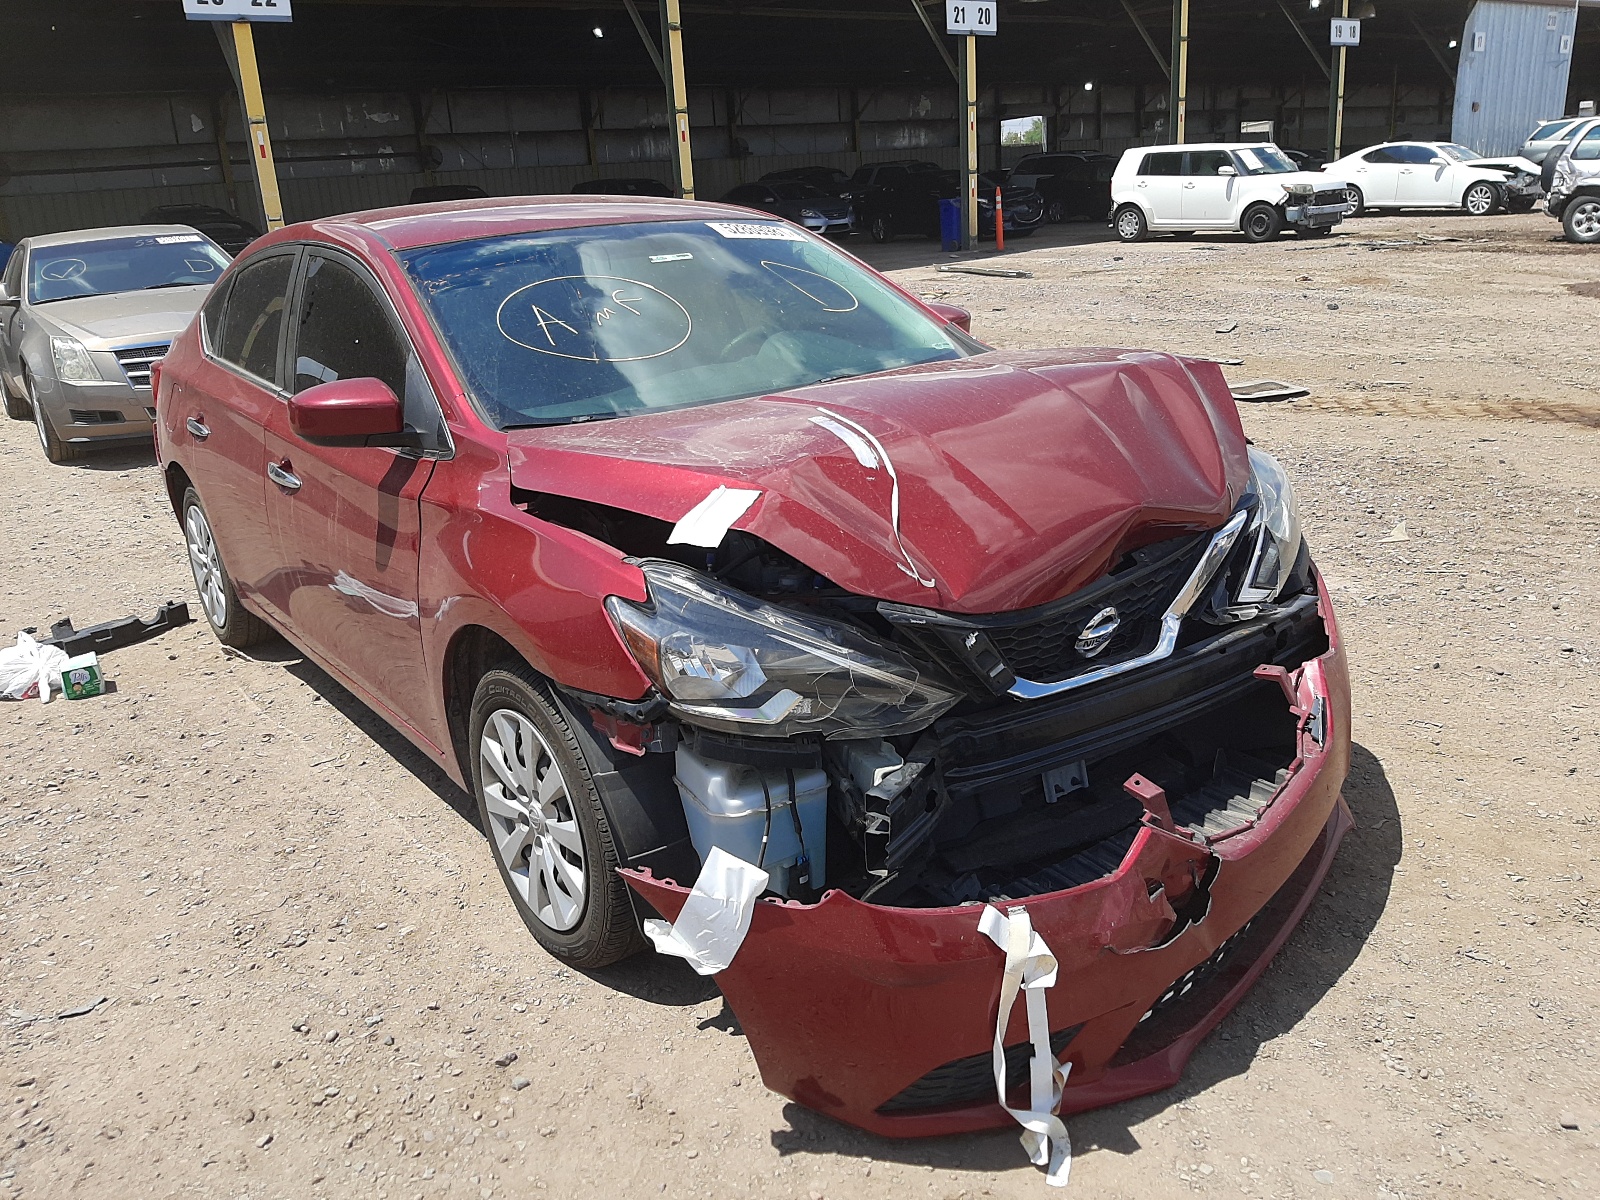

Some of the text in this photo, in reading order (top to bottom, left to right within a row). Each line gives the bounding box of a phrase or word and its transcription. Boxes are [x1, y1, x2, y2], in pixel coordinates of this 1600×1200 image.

[953, 6, 991, 25] 21 20
[1335, 25, 1356, 38] 19 18
